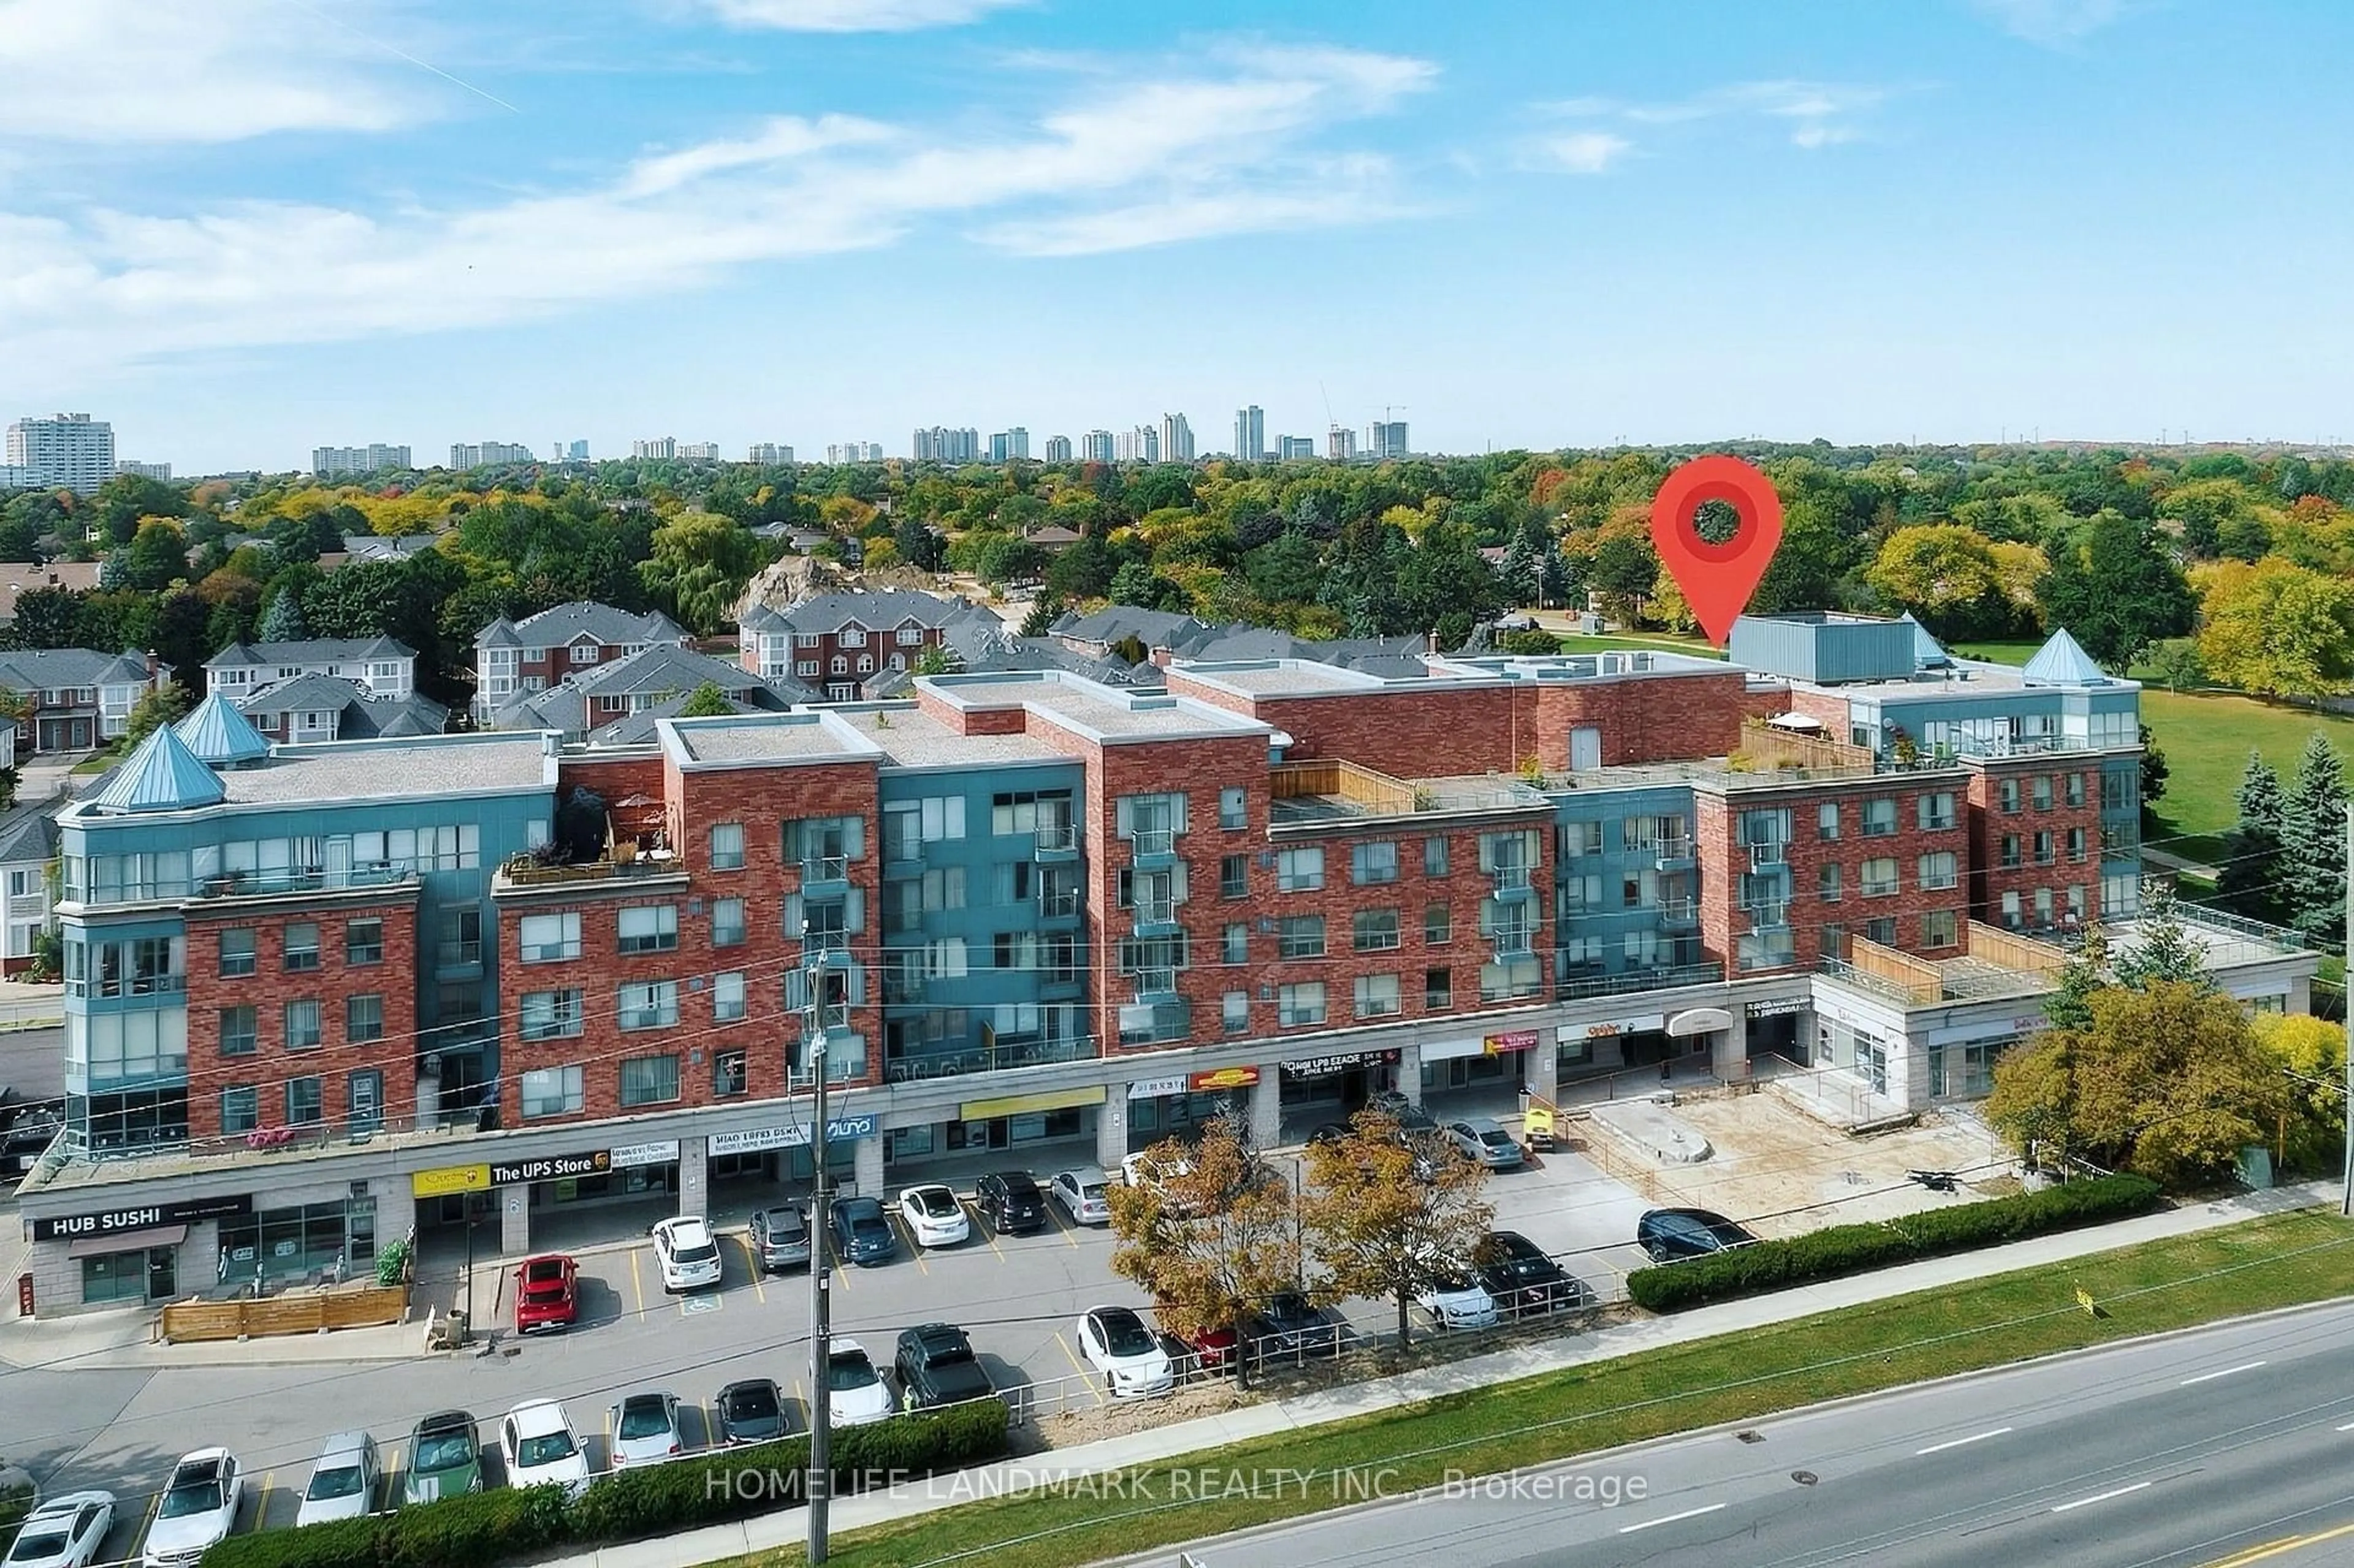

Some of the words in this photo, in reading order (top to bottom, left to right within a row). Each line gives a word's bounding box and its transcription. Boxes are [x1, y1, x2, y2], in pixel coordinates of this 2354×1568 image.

[493, 1167, 520, 1182] The
[523, 1160, 551, 1178] UPS
[555, 1159, 592, 1174] Store
[53, 1217, 95, 1235] HUB
[102, 1208, 159, 1228] SUSHI
